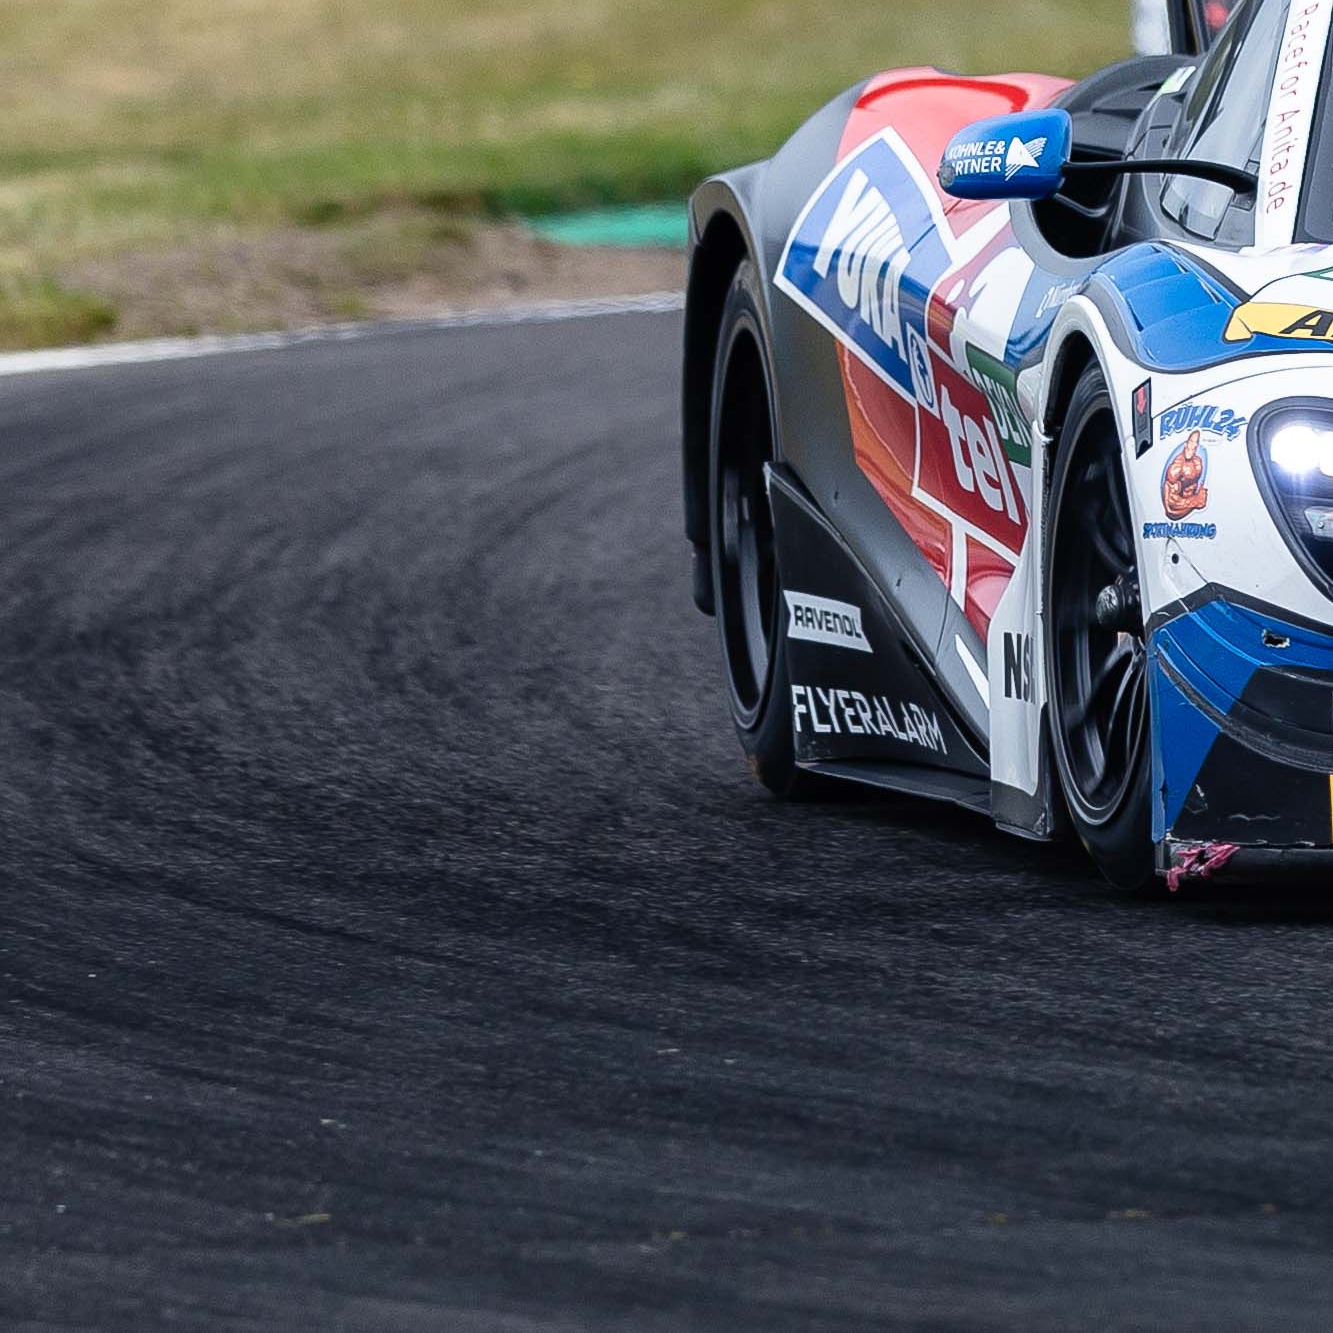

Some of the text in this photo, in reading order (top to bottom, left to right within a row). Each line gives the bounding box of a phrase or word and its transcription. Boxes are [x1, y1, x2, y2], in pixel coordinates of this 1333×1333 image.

[952, 157, 1002, 176] RTNER
[813, 168, 912, 365] YUKA
[939, 383, 1021, 526] tel
[793, 604, 862, 638] RAVENOL
[791, 684, 948, 755] FLYERALARM
